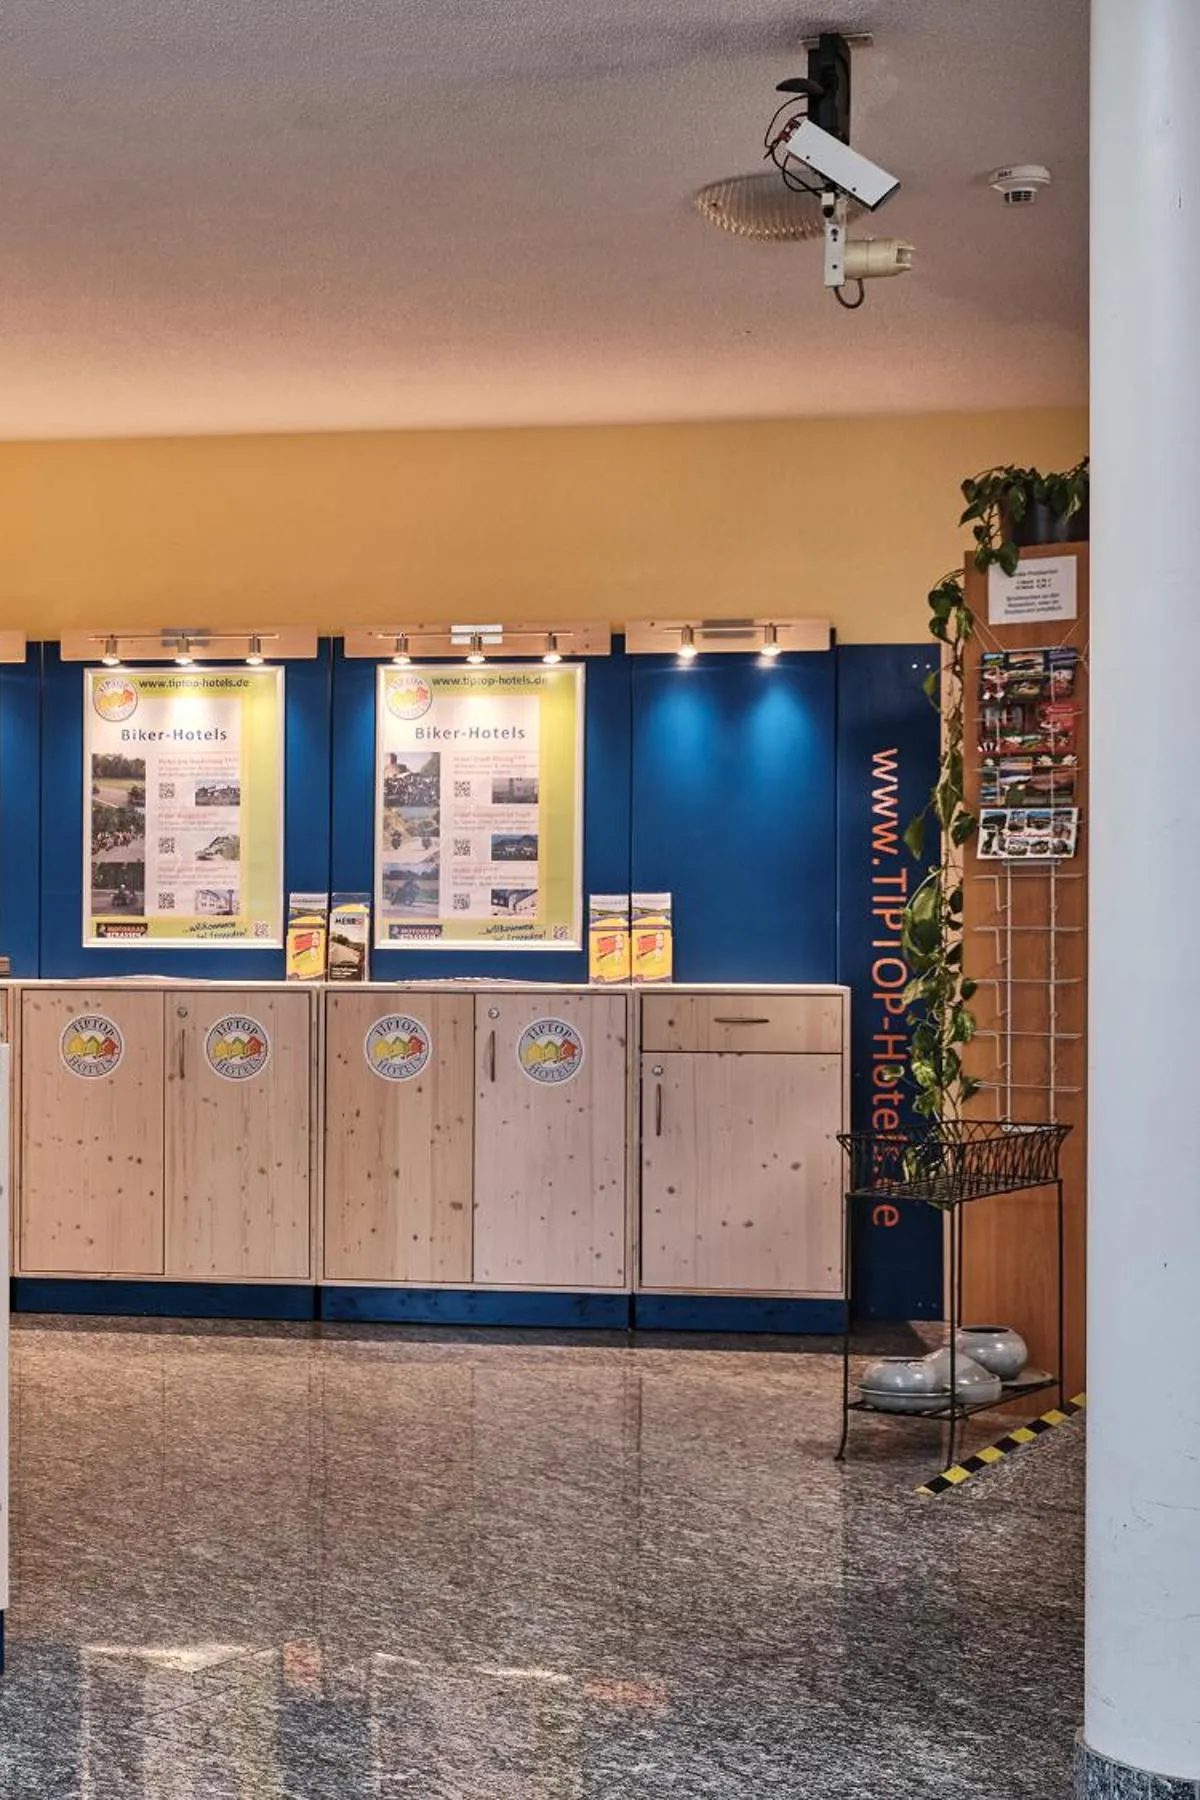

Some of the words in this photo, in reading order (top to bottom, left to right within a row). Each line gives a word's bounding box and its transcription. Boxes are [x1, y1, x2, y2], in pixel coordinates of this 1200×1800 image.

[139, 678, 249, 689] www.tiptop-hotels.de
[121, 728, 228, 742] Biker-Hotels
[415, 726, 527, 740] Biker-Hotels
[871, 748, 908, 1228] www.TIPTOP-Hotels.e
[68, 1055, 114, 1076] HOTELS
[215, 1056, 262, 1077] HOTELS
[377, 1055, 423, 1078] HOTELS
[528, 1058, 577, 1081] HOTELS
